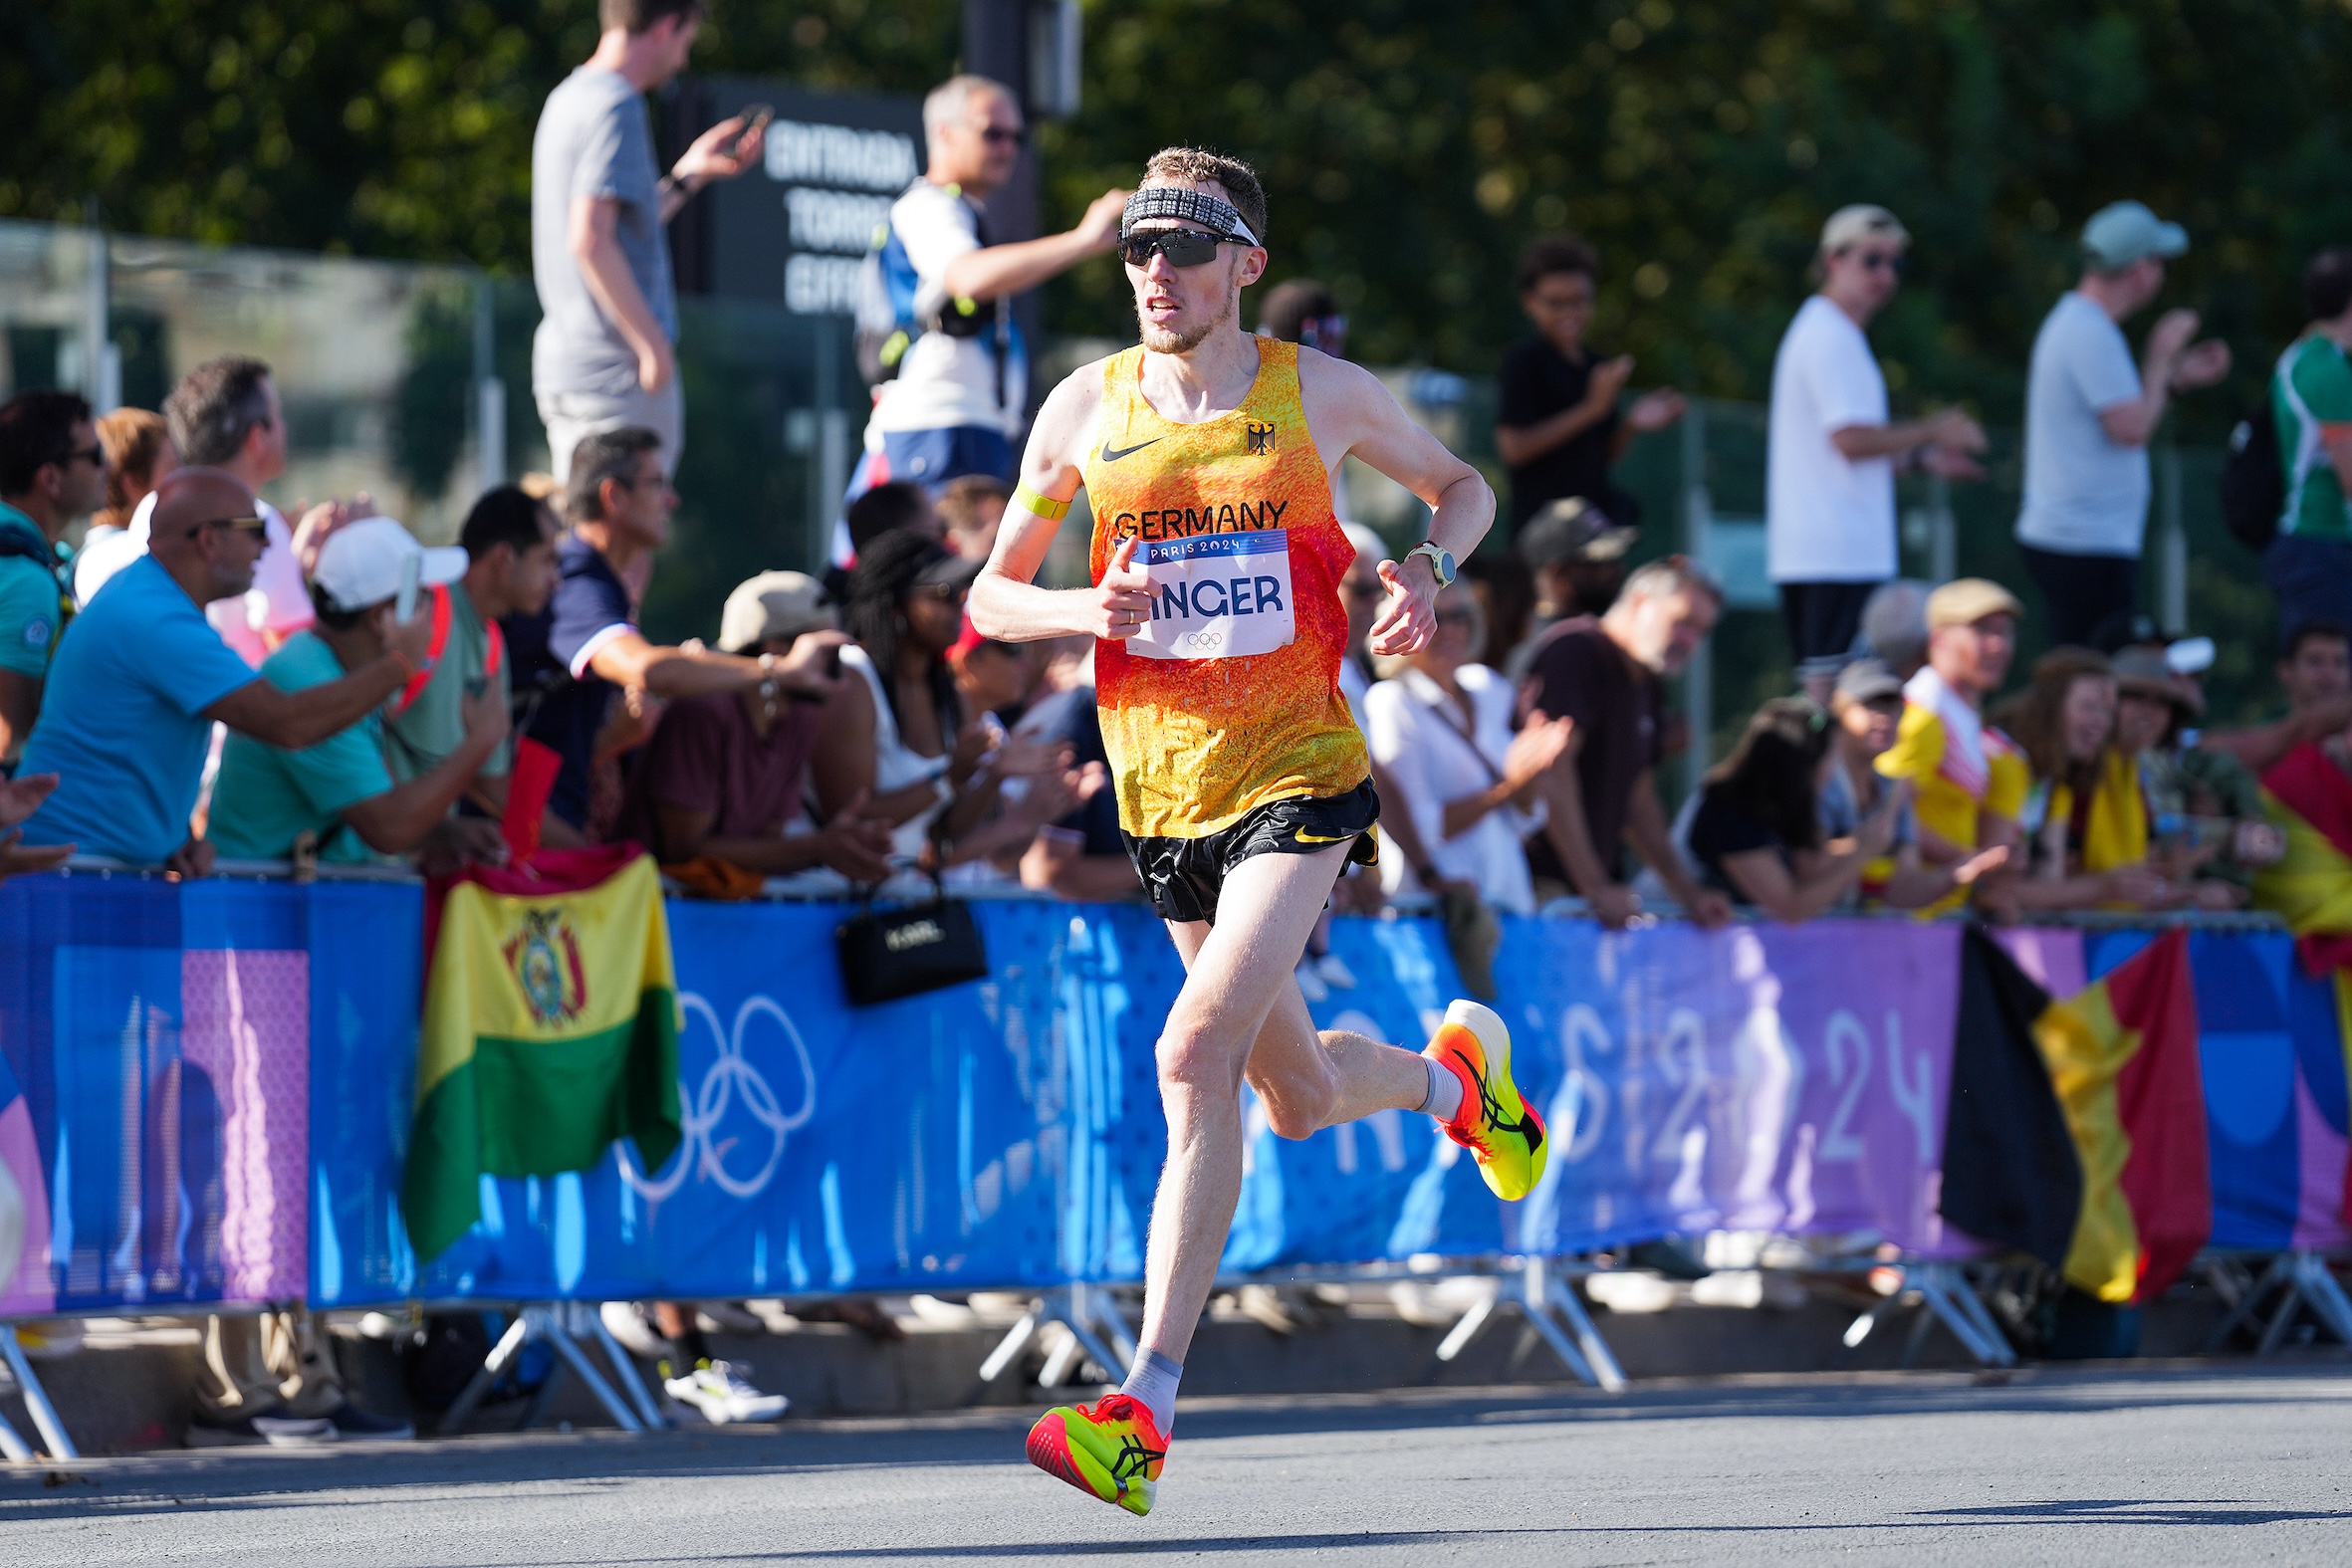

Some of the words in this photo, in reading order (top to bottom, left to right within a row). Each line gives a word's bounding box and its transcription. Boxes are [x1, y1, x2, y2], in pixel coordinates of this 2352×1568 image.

[1114, 500, 1288, 541] GERMANY
[1150, 544, 1195, 560] PARIS
[1150, 574, 1284, 621] INGER
